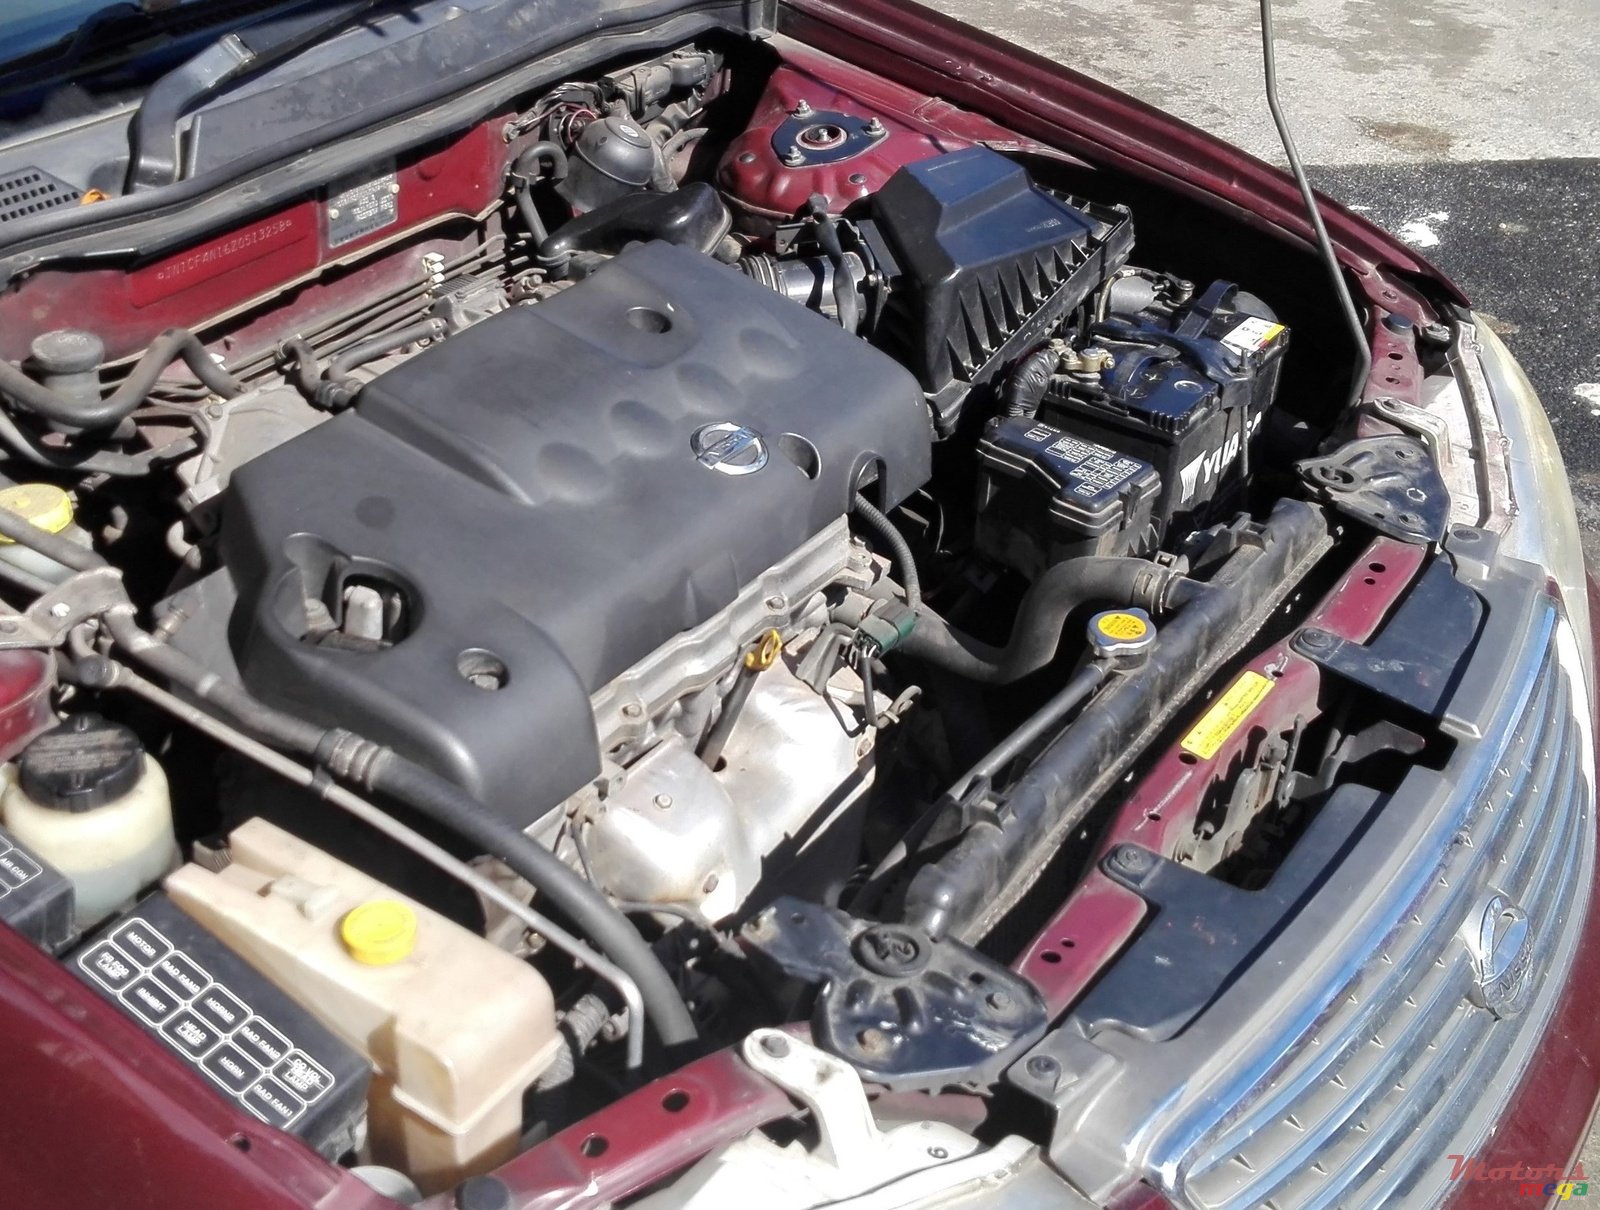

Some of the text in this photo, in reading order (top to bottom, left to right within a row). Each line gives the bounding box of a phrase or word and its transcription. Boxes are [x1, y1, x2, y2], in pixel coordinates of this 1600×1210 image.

[11, 866, 29, 881] CON
[127, 932, 157, 957] MOTOR
[96, 959, 121, 979] LAMP
[112, 960, 130, 977] FOG
[137, 987, 167, 1012] INHIBIT
[175, 1025, 201, 1046] LAMP
[183, 1020, 207, 1040] HEAD
[240, 1026, 260, 1042] RAD
[219, 1056, 246, 1079] HORN
[282, 1072, 308, 1091] LAMP
[253, 1084, 293, 1118] RAD FAN1
